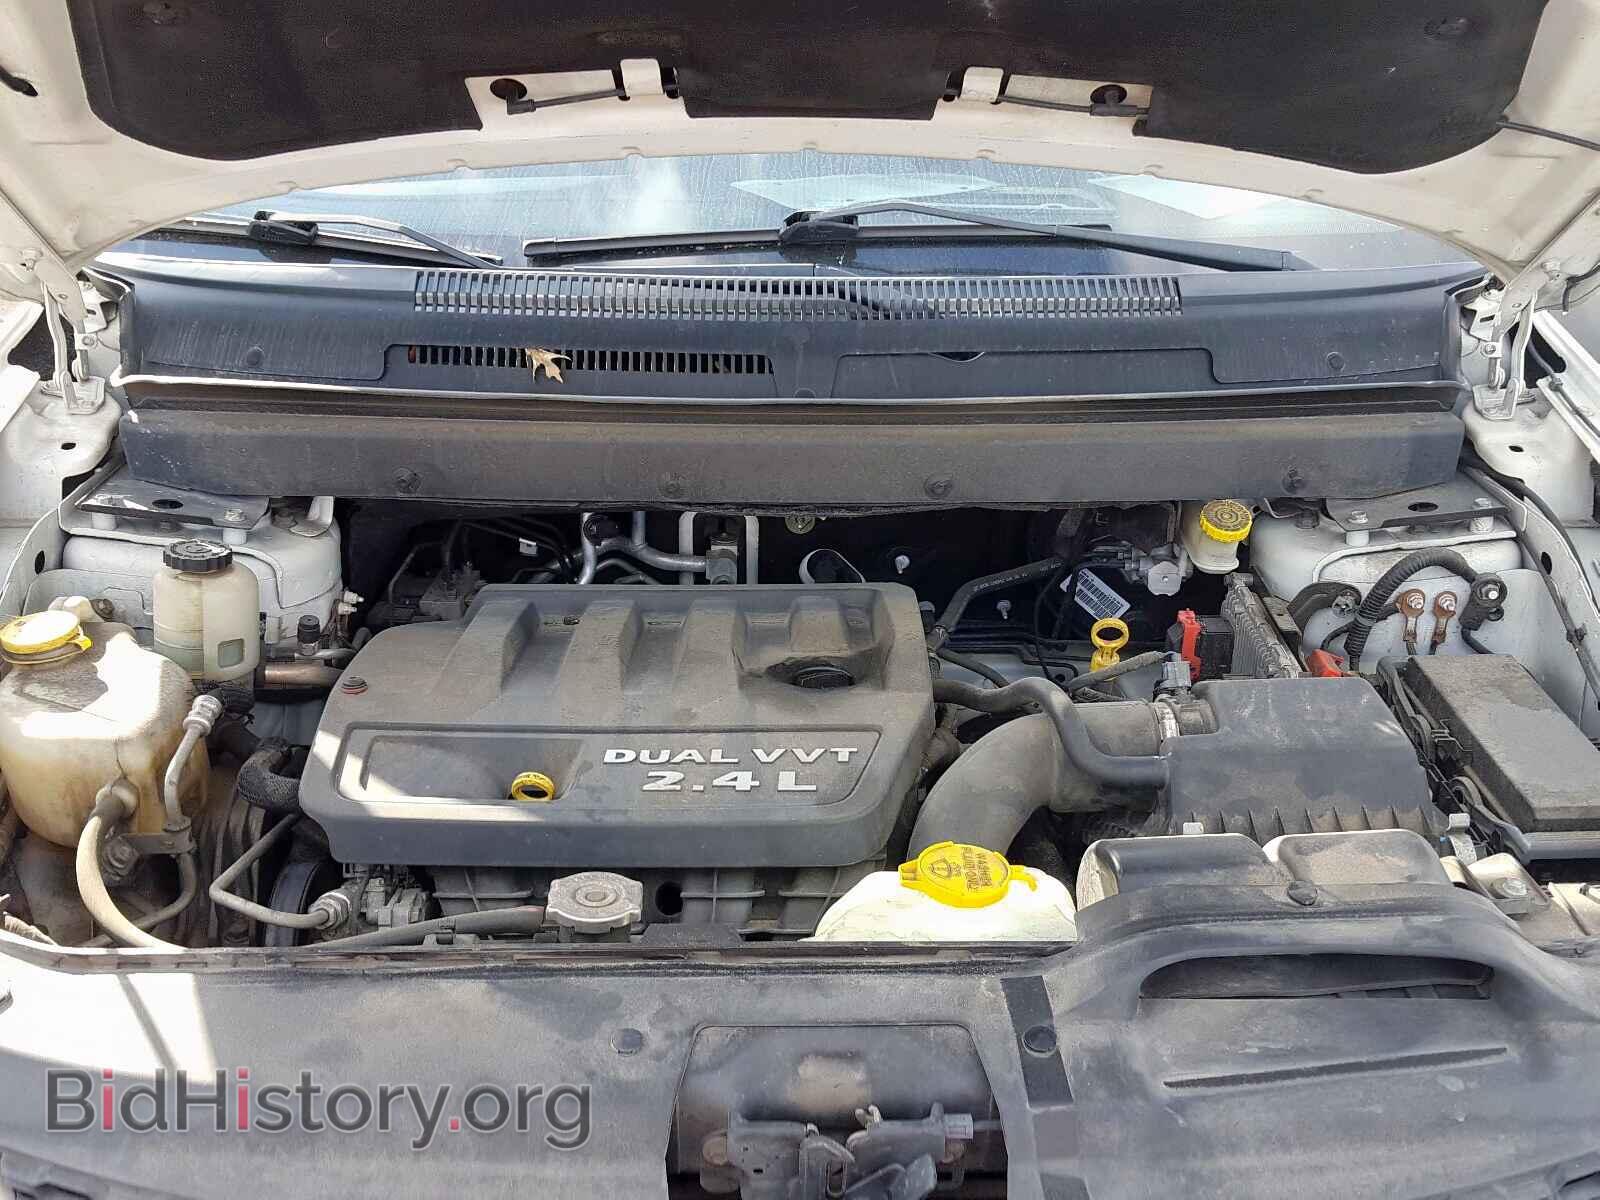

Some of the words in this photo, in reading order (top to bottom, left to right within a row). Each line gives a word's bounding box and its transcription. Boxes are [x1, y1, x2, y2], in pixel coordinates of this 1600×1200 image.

[603, 748, 739, 764] DUAL
[751, 748, 858, 764] VVT
[642, 770, 761, 792] 2.4
[976, 852, 993, 888] WASHER
